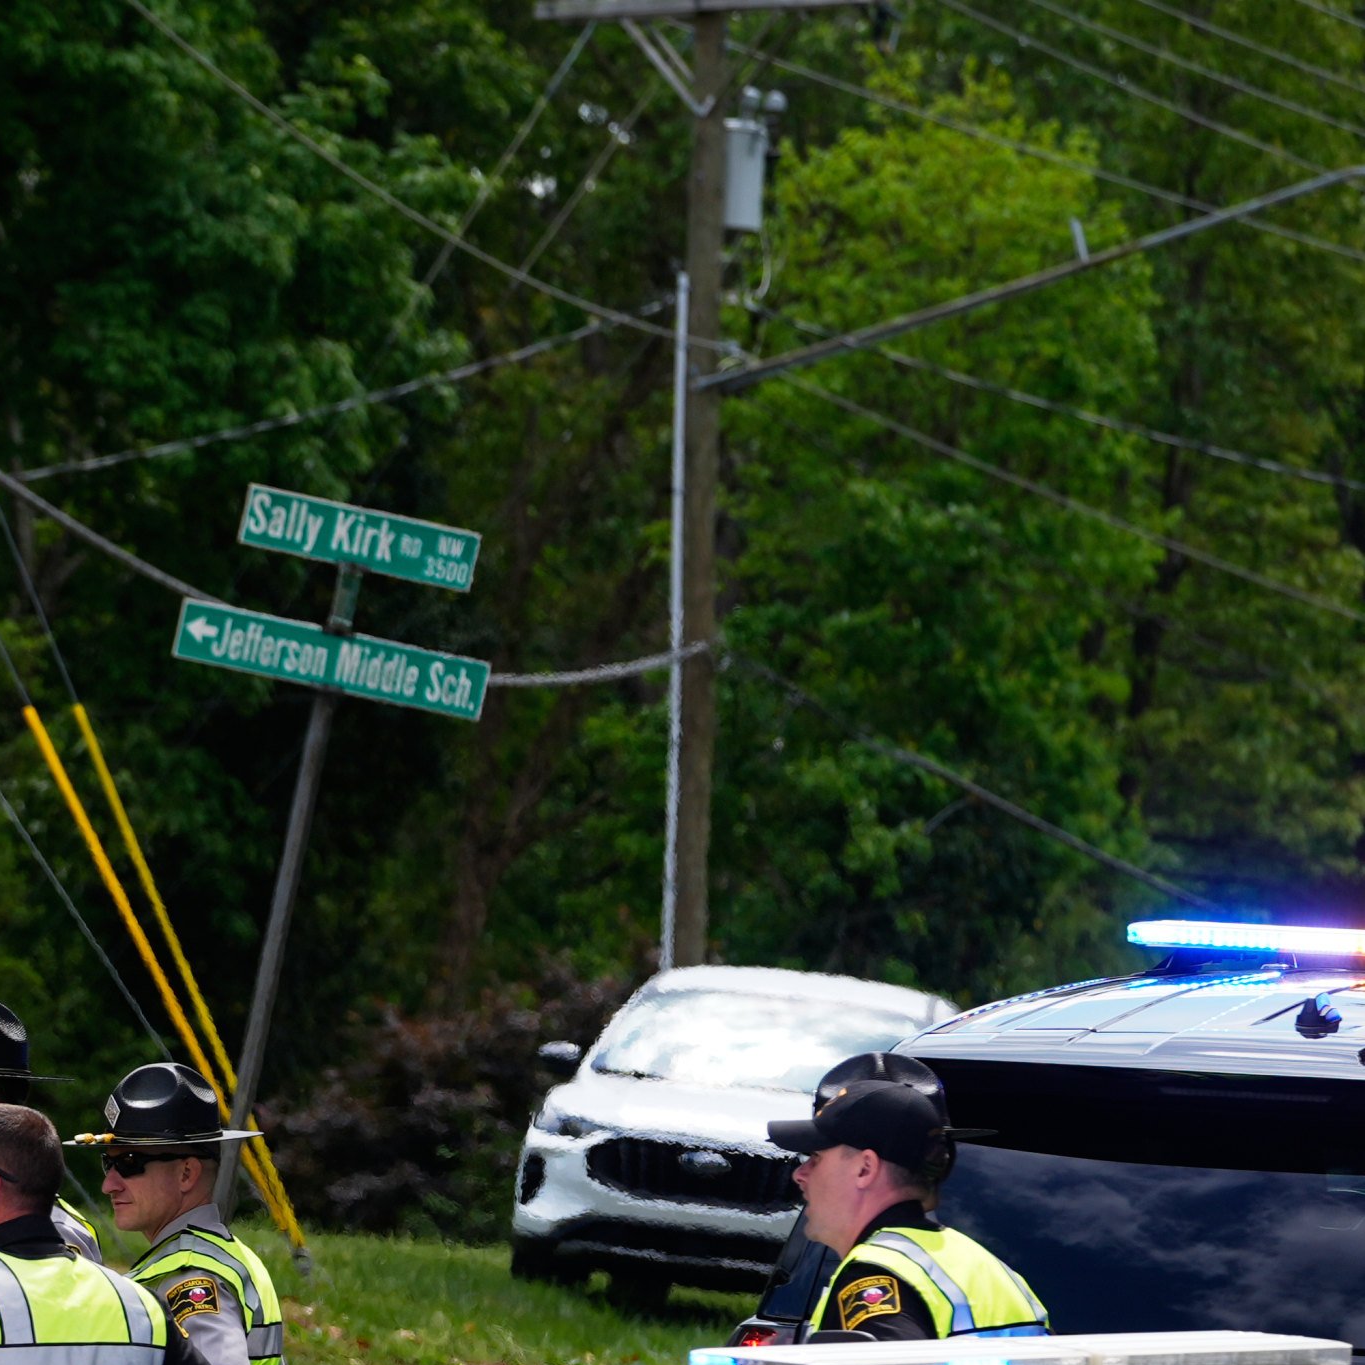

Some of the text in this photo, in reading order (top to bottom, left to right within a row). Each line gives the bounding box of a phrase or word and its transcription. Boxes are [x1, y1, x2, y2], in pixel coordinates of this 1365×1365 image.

[247, 492, 324, 551] Sally
[330, 510, 396, 563] Kirk
[438, 534, 466, 557] NW
[424, 556, 469, 584] 3500
[210, 617, 476, 712] Jefferson Middle Sch.
